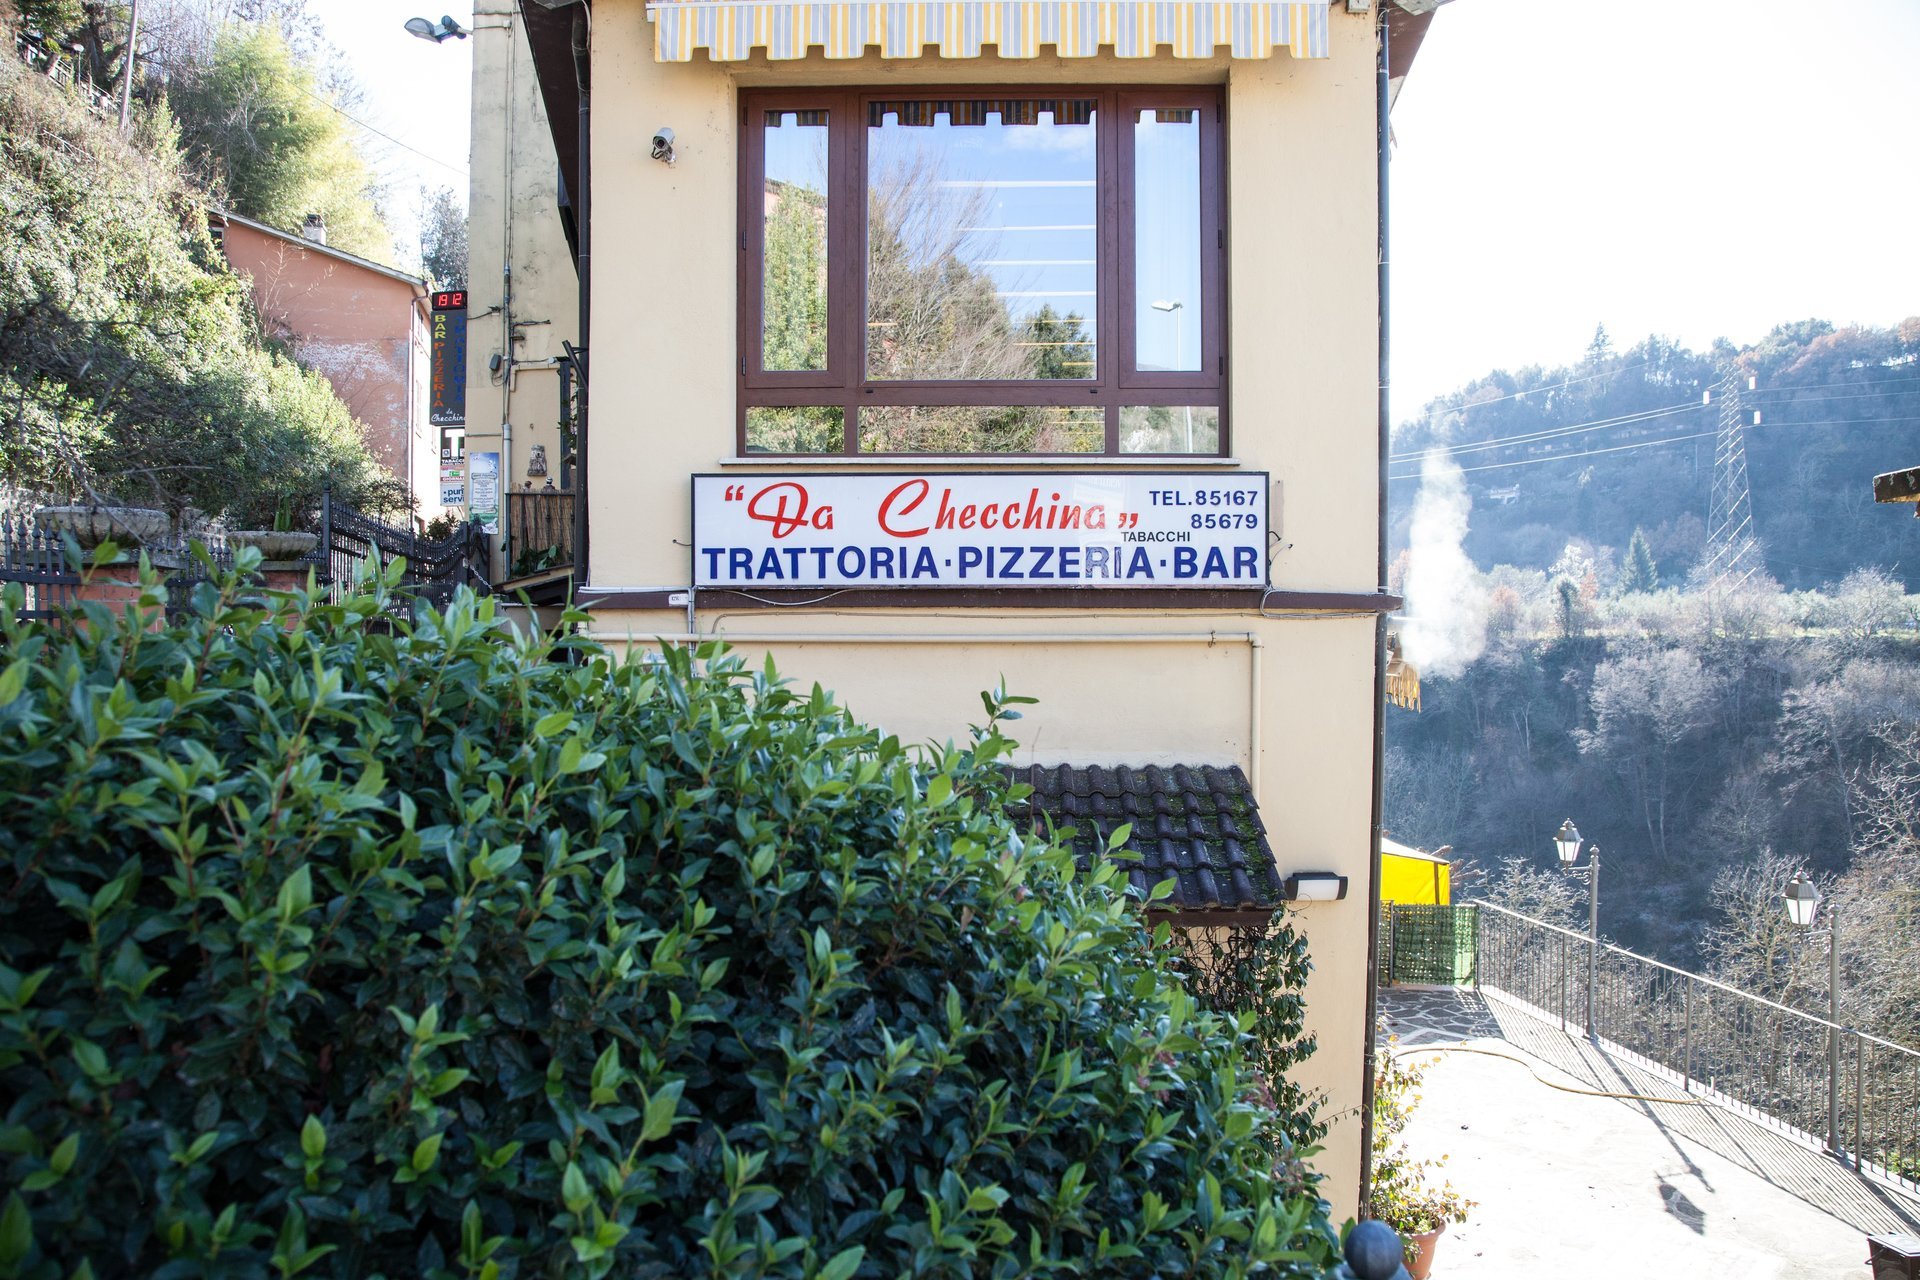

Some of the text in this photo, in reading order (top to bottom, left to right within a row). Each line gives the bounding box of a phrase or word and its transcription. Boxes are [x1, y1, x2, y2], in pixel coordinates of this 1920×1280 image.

[433, 315, 446, 407] BAR PIZZERIA
[1191, 514, 1258, 529] 85679
[1121, 531, 1190, 542] TABACCHI
